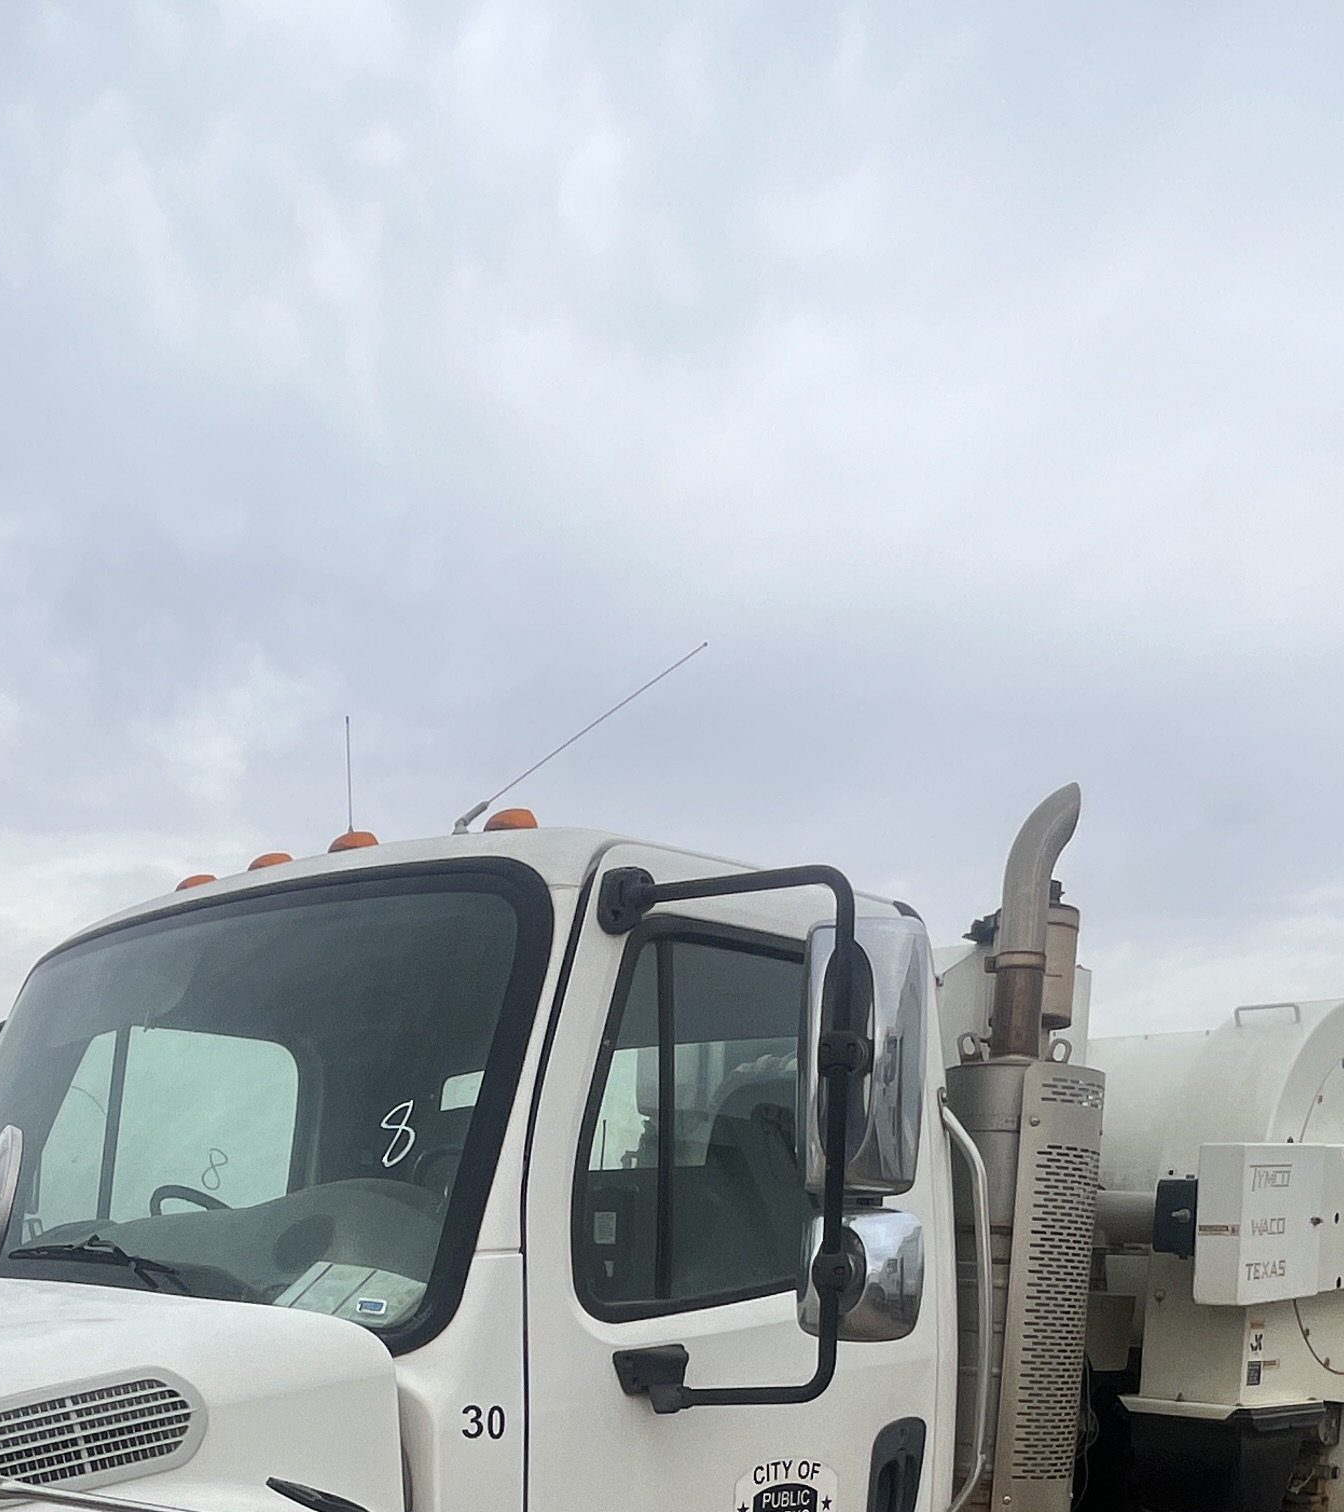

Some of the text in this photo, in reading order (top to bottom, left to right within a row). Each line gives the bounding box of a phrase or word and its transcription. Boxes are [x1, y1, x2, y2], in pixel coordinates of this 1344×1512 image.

[381, 1100, 416, 1168] 8
[1251, 1218, 1286, 1237] WACO
[1245, 1260, 1286, 1281] TEXAS
[462, 1404, 505, 1439] 30
[753, 1460, 821, 1485] CITY OF
[762, 1489, 810, 1509] PUBLIC
